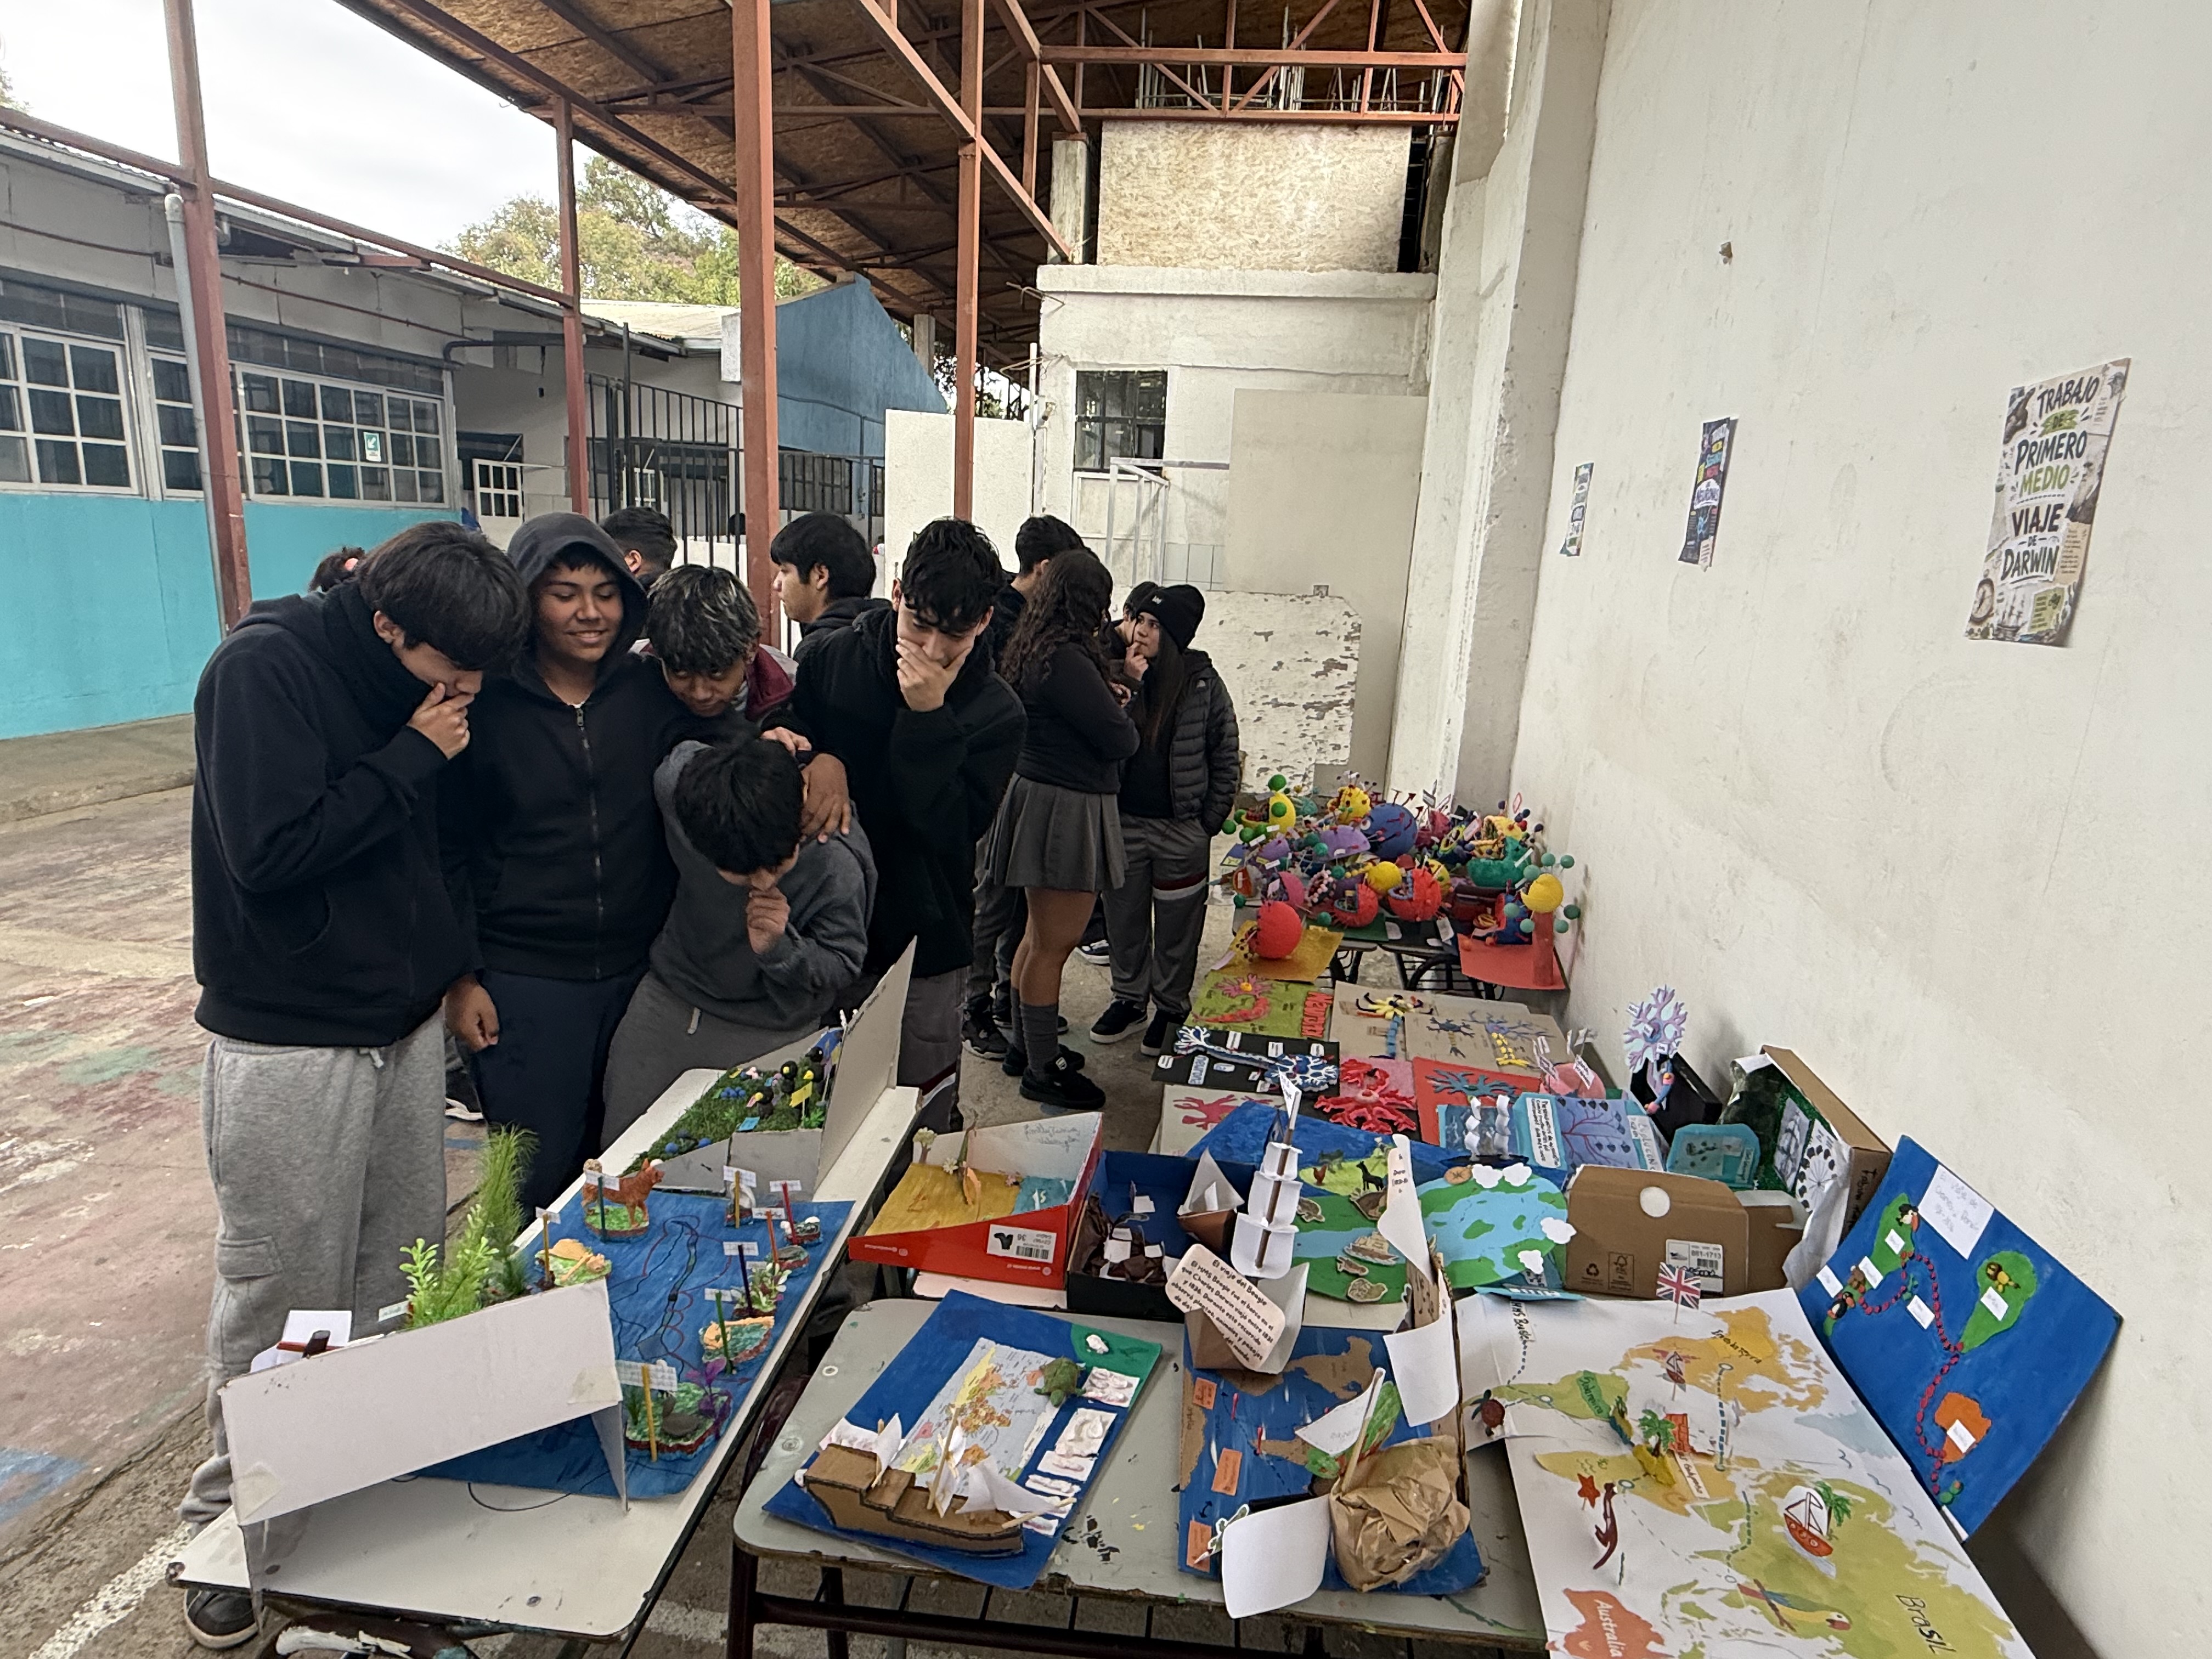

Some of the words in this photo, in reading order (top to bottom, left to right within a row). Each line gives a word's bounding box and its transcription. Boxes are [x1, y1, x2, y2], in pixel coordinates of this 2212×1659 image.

[2037, 376, 2100, 419] TRABAJO
[2015, 431, 2087, 475] PRIMERO
[2019, 464, 2070, 497] MEDIO
[2012, 503, 2064, 537] VIAJE
[2028, 535, 2038, 547] DE
[2001, 545, 2059, 580] DARWIN
[1182, 1266, 1192, 1276] que
[1193, 1273, 1215, 1293] Charles
[1215, 1290, 1234, 1308] Darwin
[1248, 1318, 1262, 1333] entre
[1198, 1265, 1212, 1278] HMS
[1212, 1276, 1231, 1292] Beagle
[1231, 1290, 1240, 1301] fue
[1246, 1302, 1261, 1319] barco
[1212, 1260, 1220, 1268] El
[1220, 1266, 1236, 1280] viaje
[1237, 1278, 1247, 1288] del
[1246, 1285, 1267, 1306] Beagle
[1203, 1293, 1226, 1313] Durante
[1226, 1312, 1238, 1323] este
[1237, 1322, 1261, 1346] recorrido
[1216, 1316, 1238, 1338] animales
[1593, 1599, 1627, 1657] Australia
